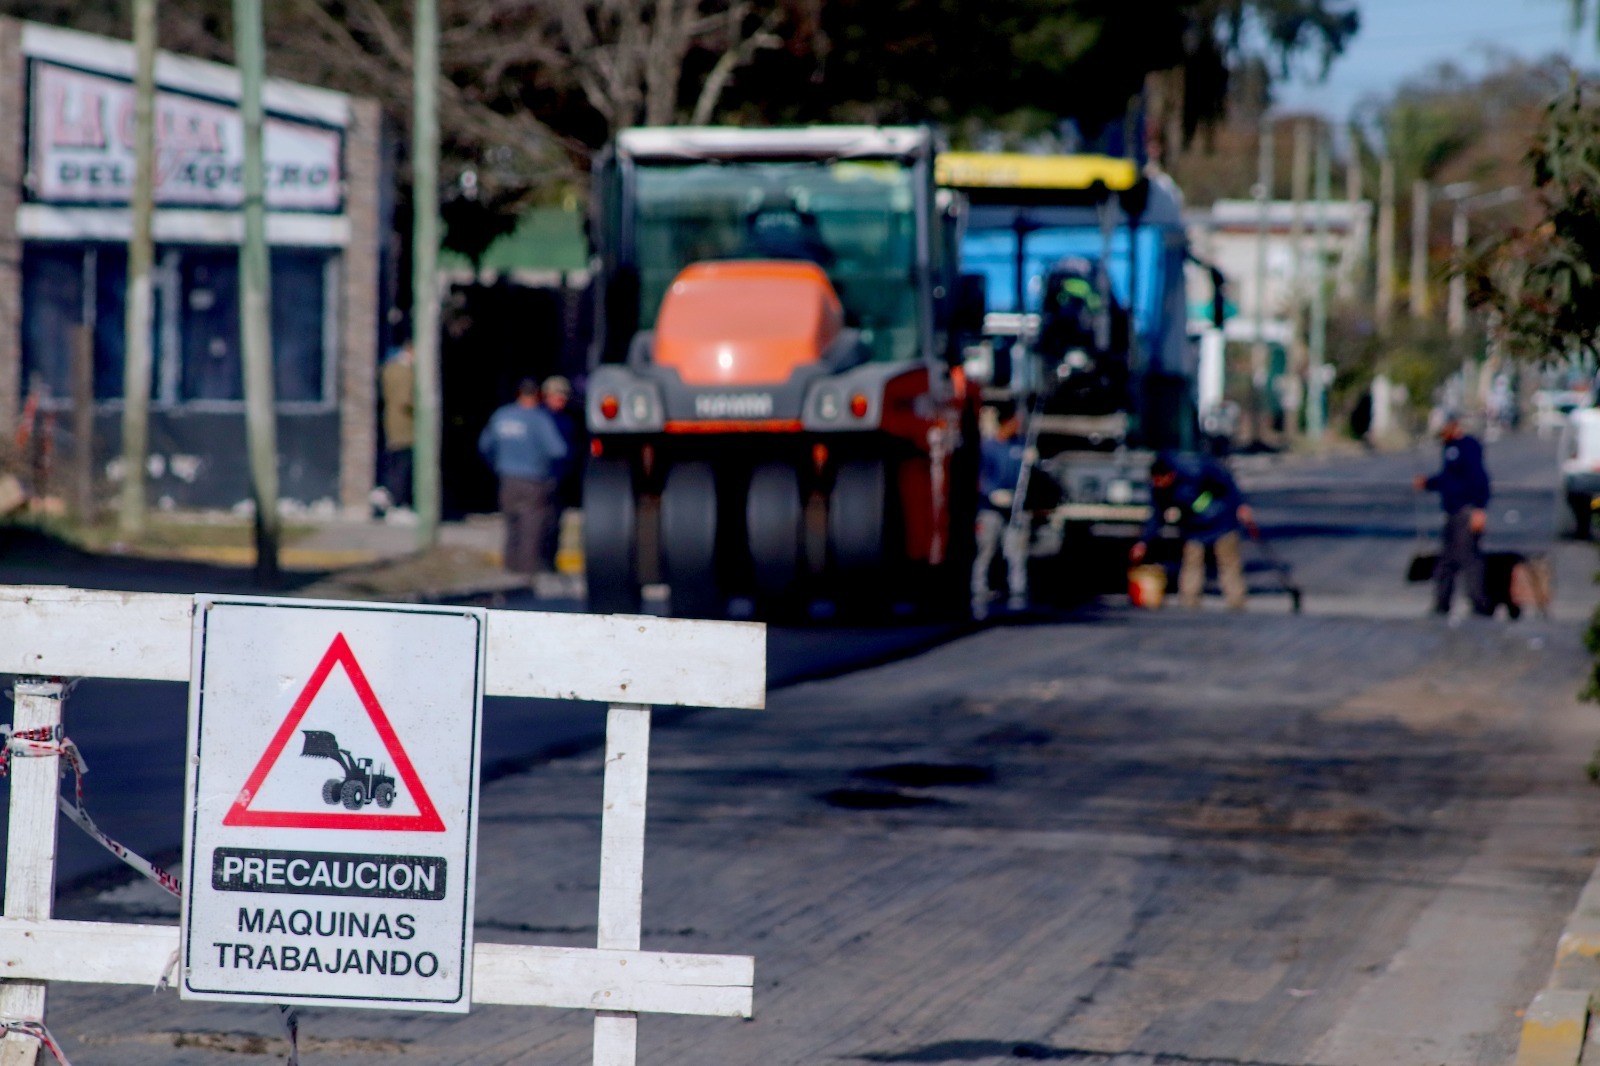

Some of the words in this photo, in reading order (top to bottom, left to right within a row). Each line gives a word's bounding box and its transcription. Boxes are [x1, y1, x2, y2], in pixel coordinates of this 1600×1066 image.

[58, 159, 128, 185] DEL
[222, 856, 436, 892] PRECAUCION
[238, 907, 416, 940] MAQUINAS
[212, 943, 439, 978] TRABAJANDO
